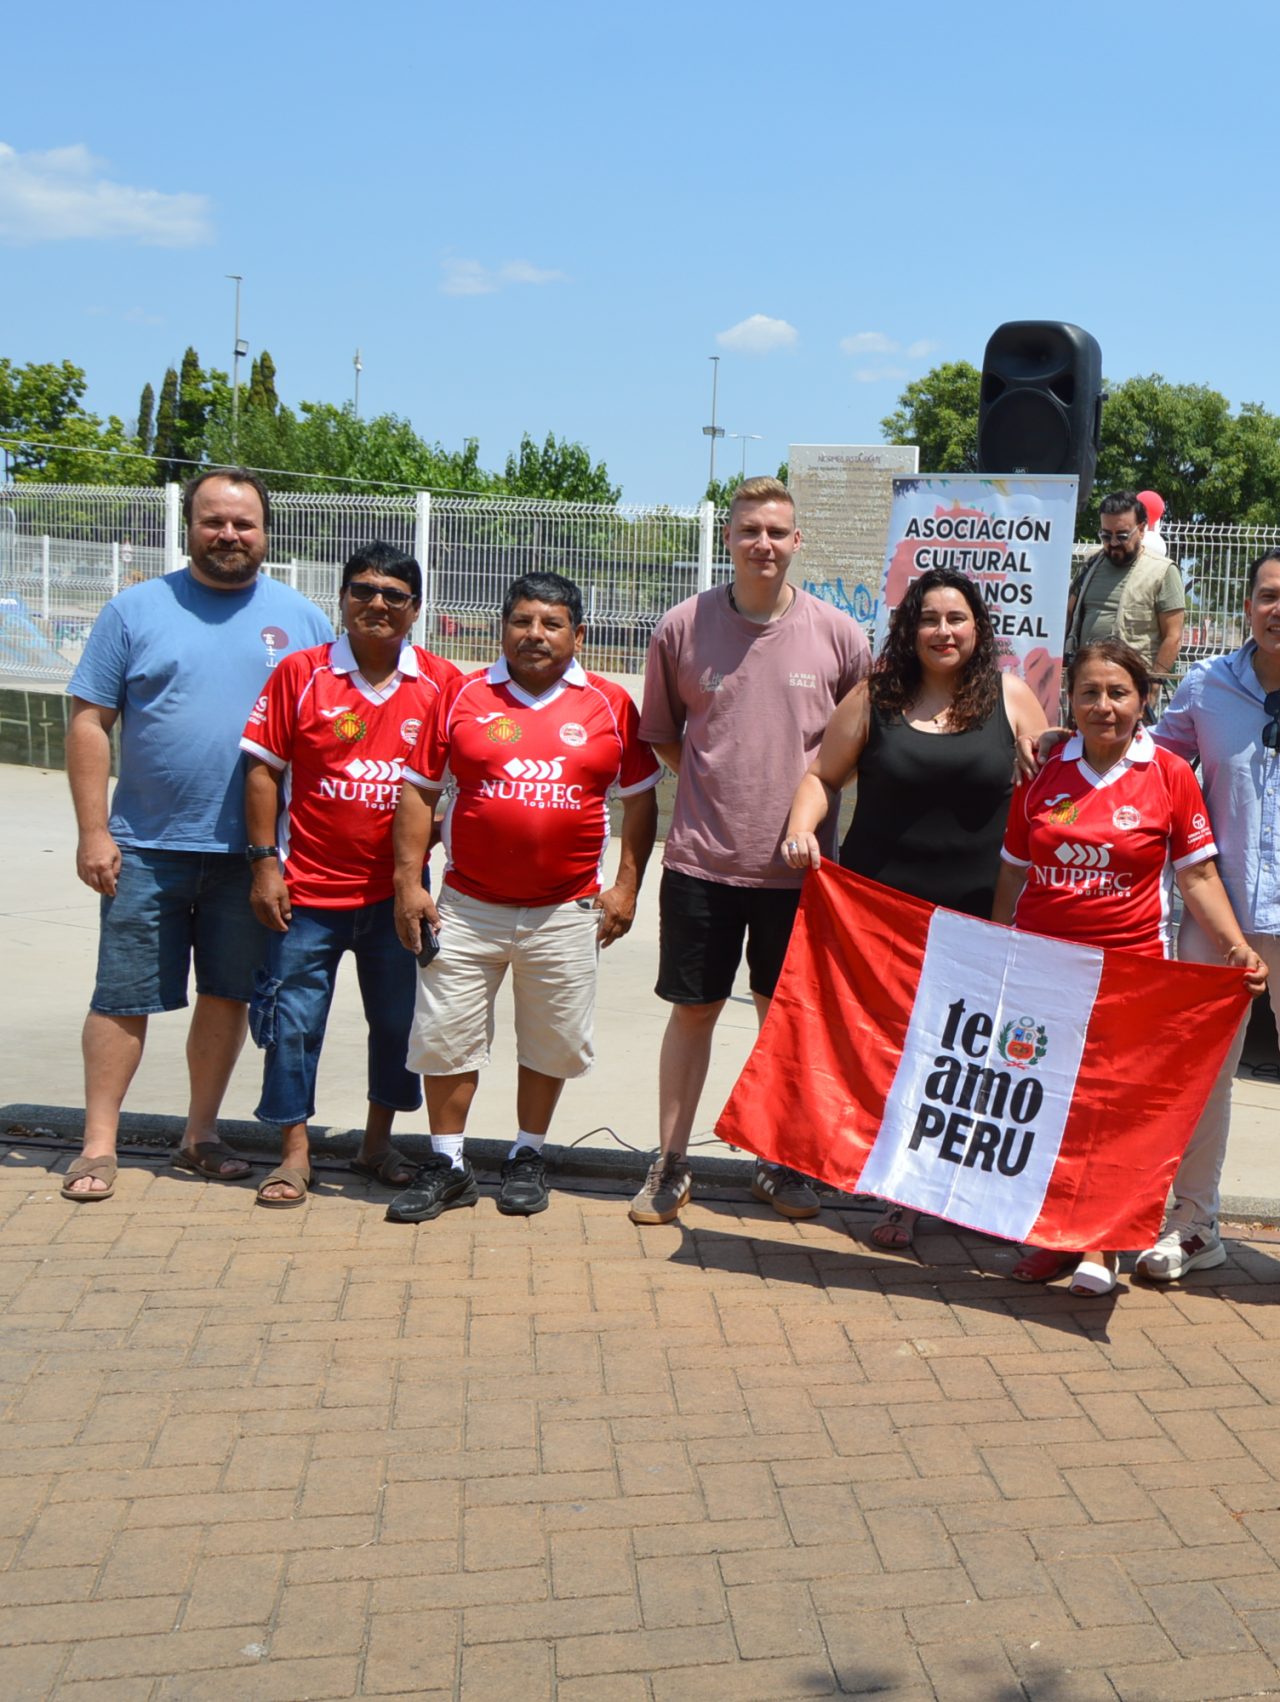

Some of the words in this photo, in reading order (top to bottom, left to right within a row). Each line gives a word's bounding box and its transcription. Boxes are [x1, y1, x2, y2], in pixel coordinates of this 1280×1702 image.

[905, 516, 1051, 542] ASOCIACIÓN
[915, 549, 1032, 573] CULTURAL
[480, 779, 583, 803] NUPPEC
[524, 800, 581, 810] logistica
[1035, 865, 1133, 891] NUPPEC
[1074, 888, 1131, 898] logistica
[941, 998, 994, 1058] te
[924, 1055, 1043, 1124] amo
[907, 1102, 1036, 1177] PERU
